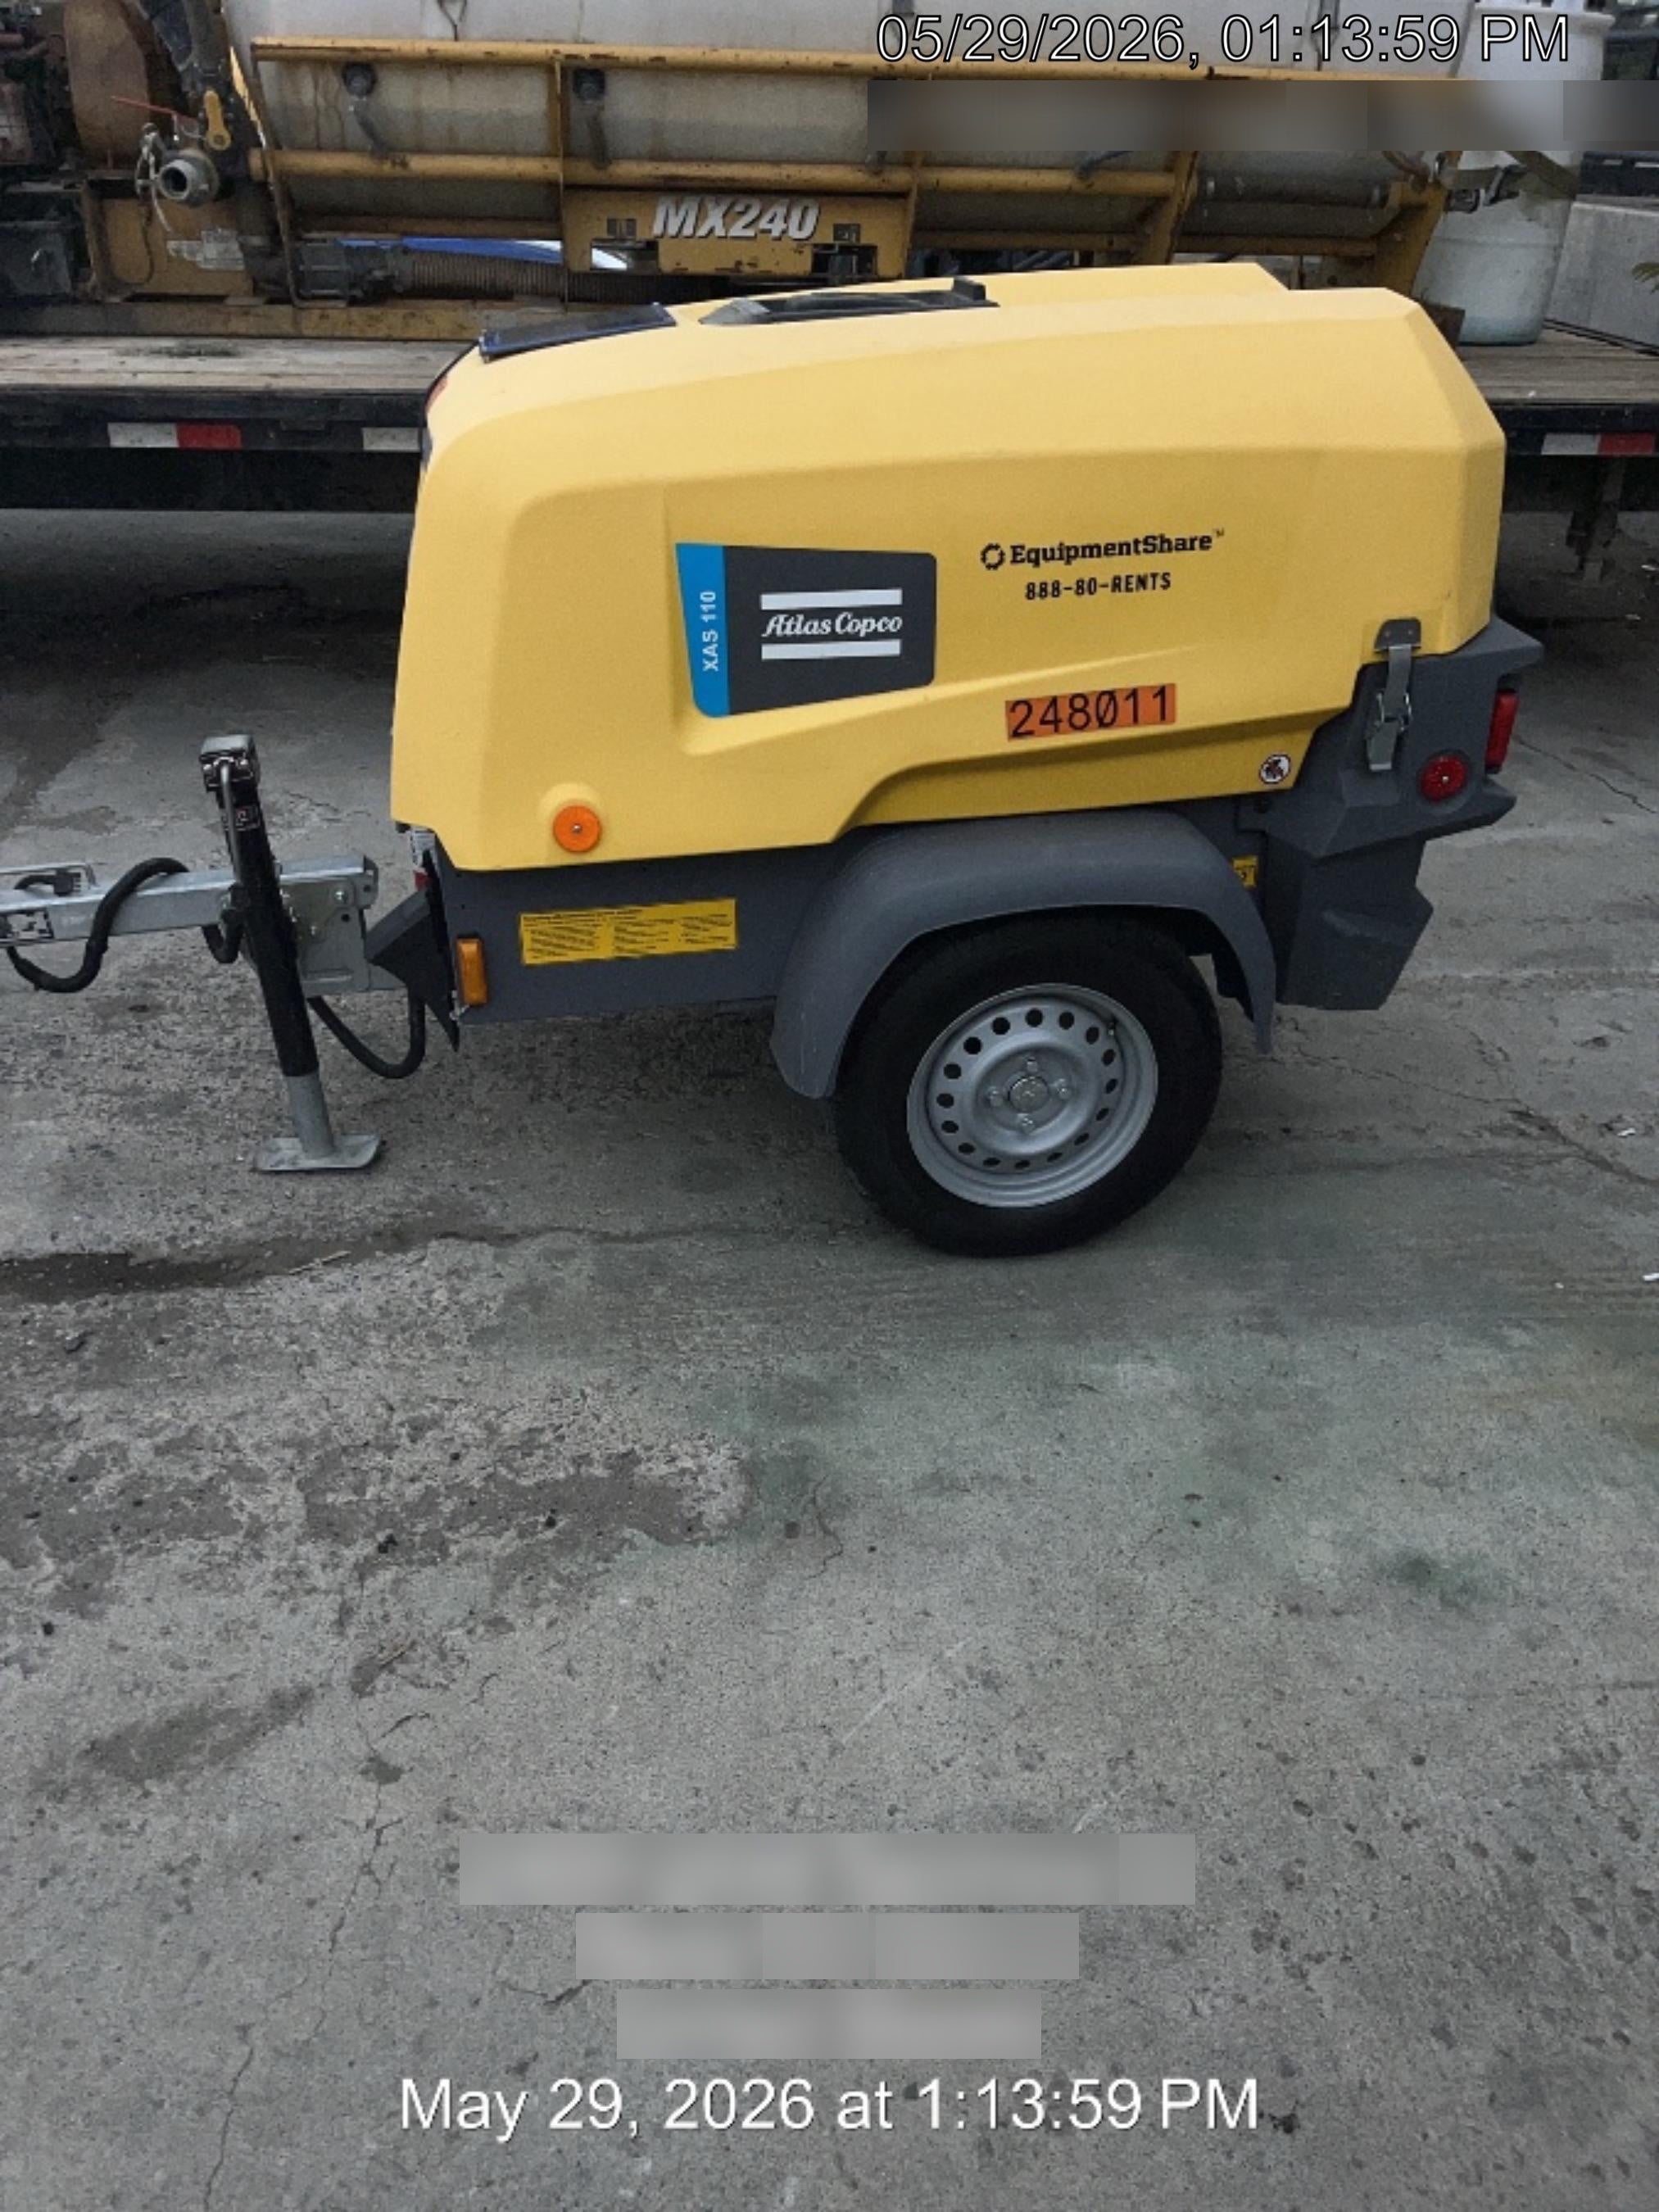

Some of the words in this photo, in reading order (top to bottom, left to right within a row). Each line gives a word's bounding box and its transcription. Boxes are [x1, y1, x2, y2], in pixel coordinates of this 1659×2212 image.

[652, 195, 820, 240] MX240
[1009, 533, 1213, 568] EquipmentShare
[1024, 572, 1172, 600] 888-80-RENTS
[700, 591, 717, 623] 110
[761, 614, 832, 637] Atlas
[834, 611, 903, 640] Copco
[701, 631, 719, 672] XAS
[1009, 684, 1168, 739] 248011
